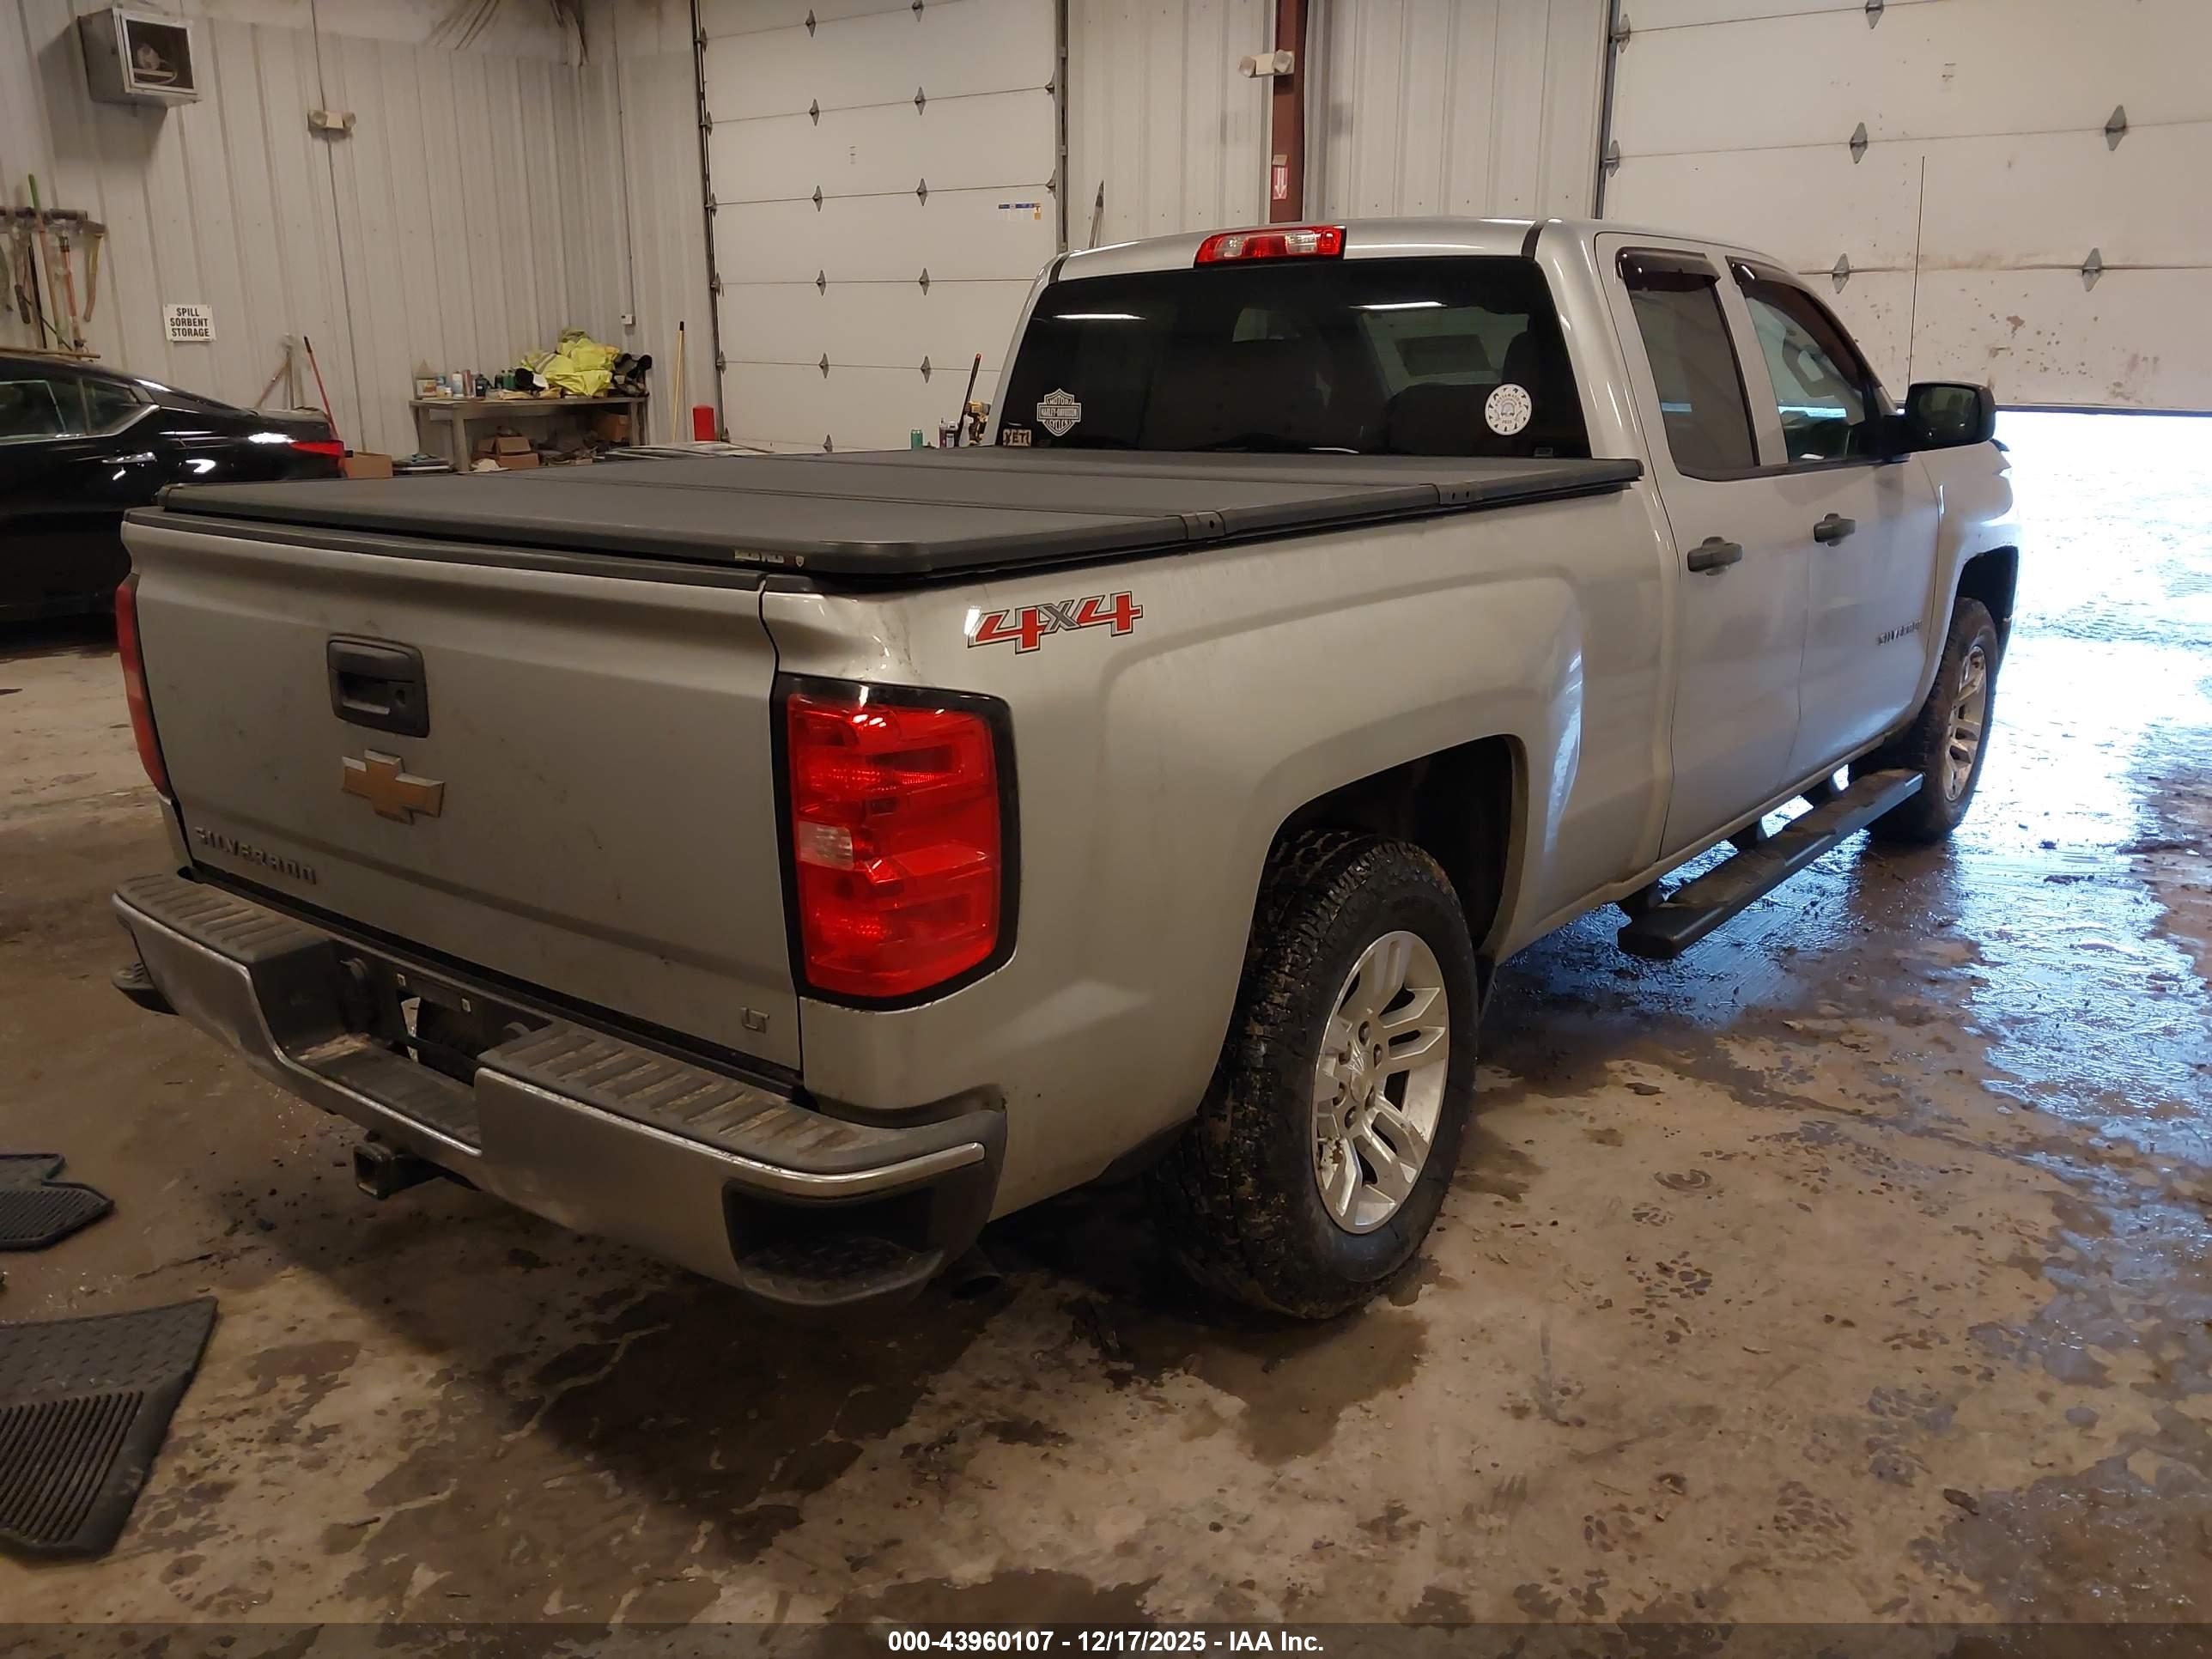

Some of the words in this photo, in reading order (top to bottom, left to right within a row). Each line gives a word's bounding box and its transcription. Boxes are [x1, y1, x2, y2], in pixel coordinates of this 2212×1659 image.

[176, 307, 200, 317] SPILL
[170, 317, 209, 327] SORBENT
[171, 327, 210, 337] STORAGE
[1048, 396, 1070, 405] MOTOR
[1004, 430, 1030, 446] YETI
[194, 826, 317, 885] SILVERADO
[739, 1006, 770, 1034] LT
